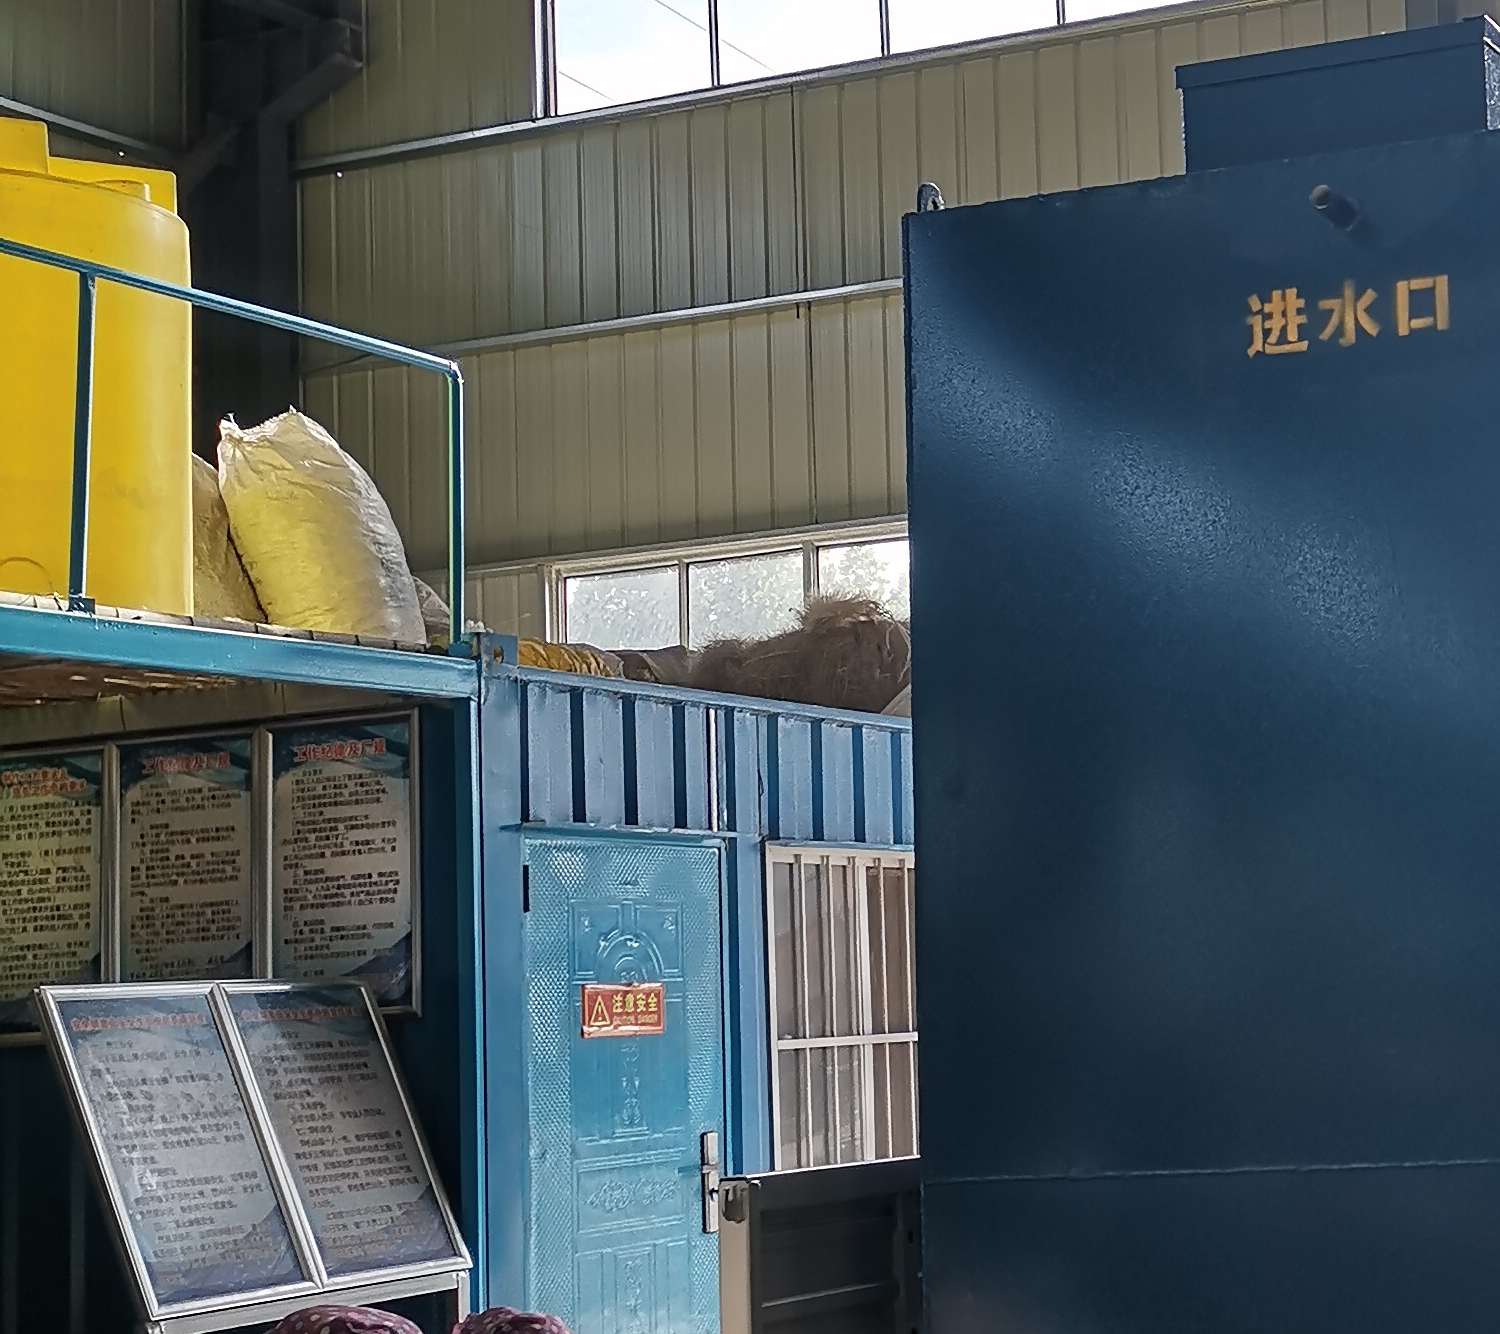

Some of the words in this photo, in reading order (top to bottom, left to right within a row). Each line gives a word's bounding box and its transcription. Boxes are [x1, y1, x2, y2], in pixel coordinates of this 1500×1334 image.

[1245, 274, 1451, 359] 进水口
[612, 992, 658, 1013] 注意安全
